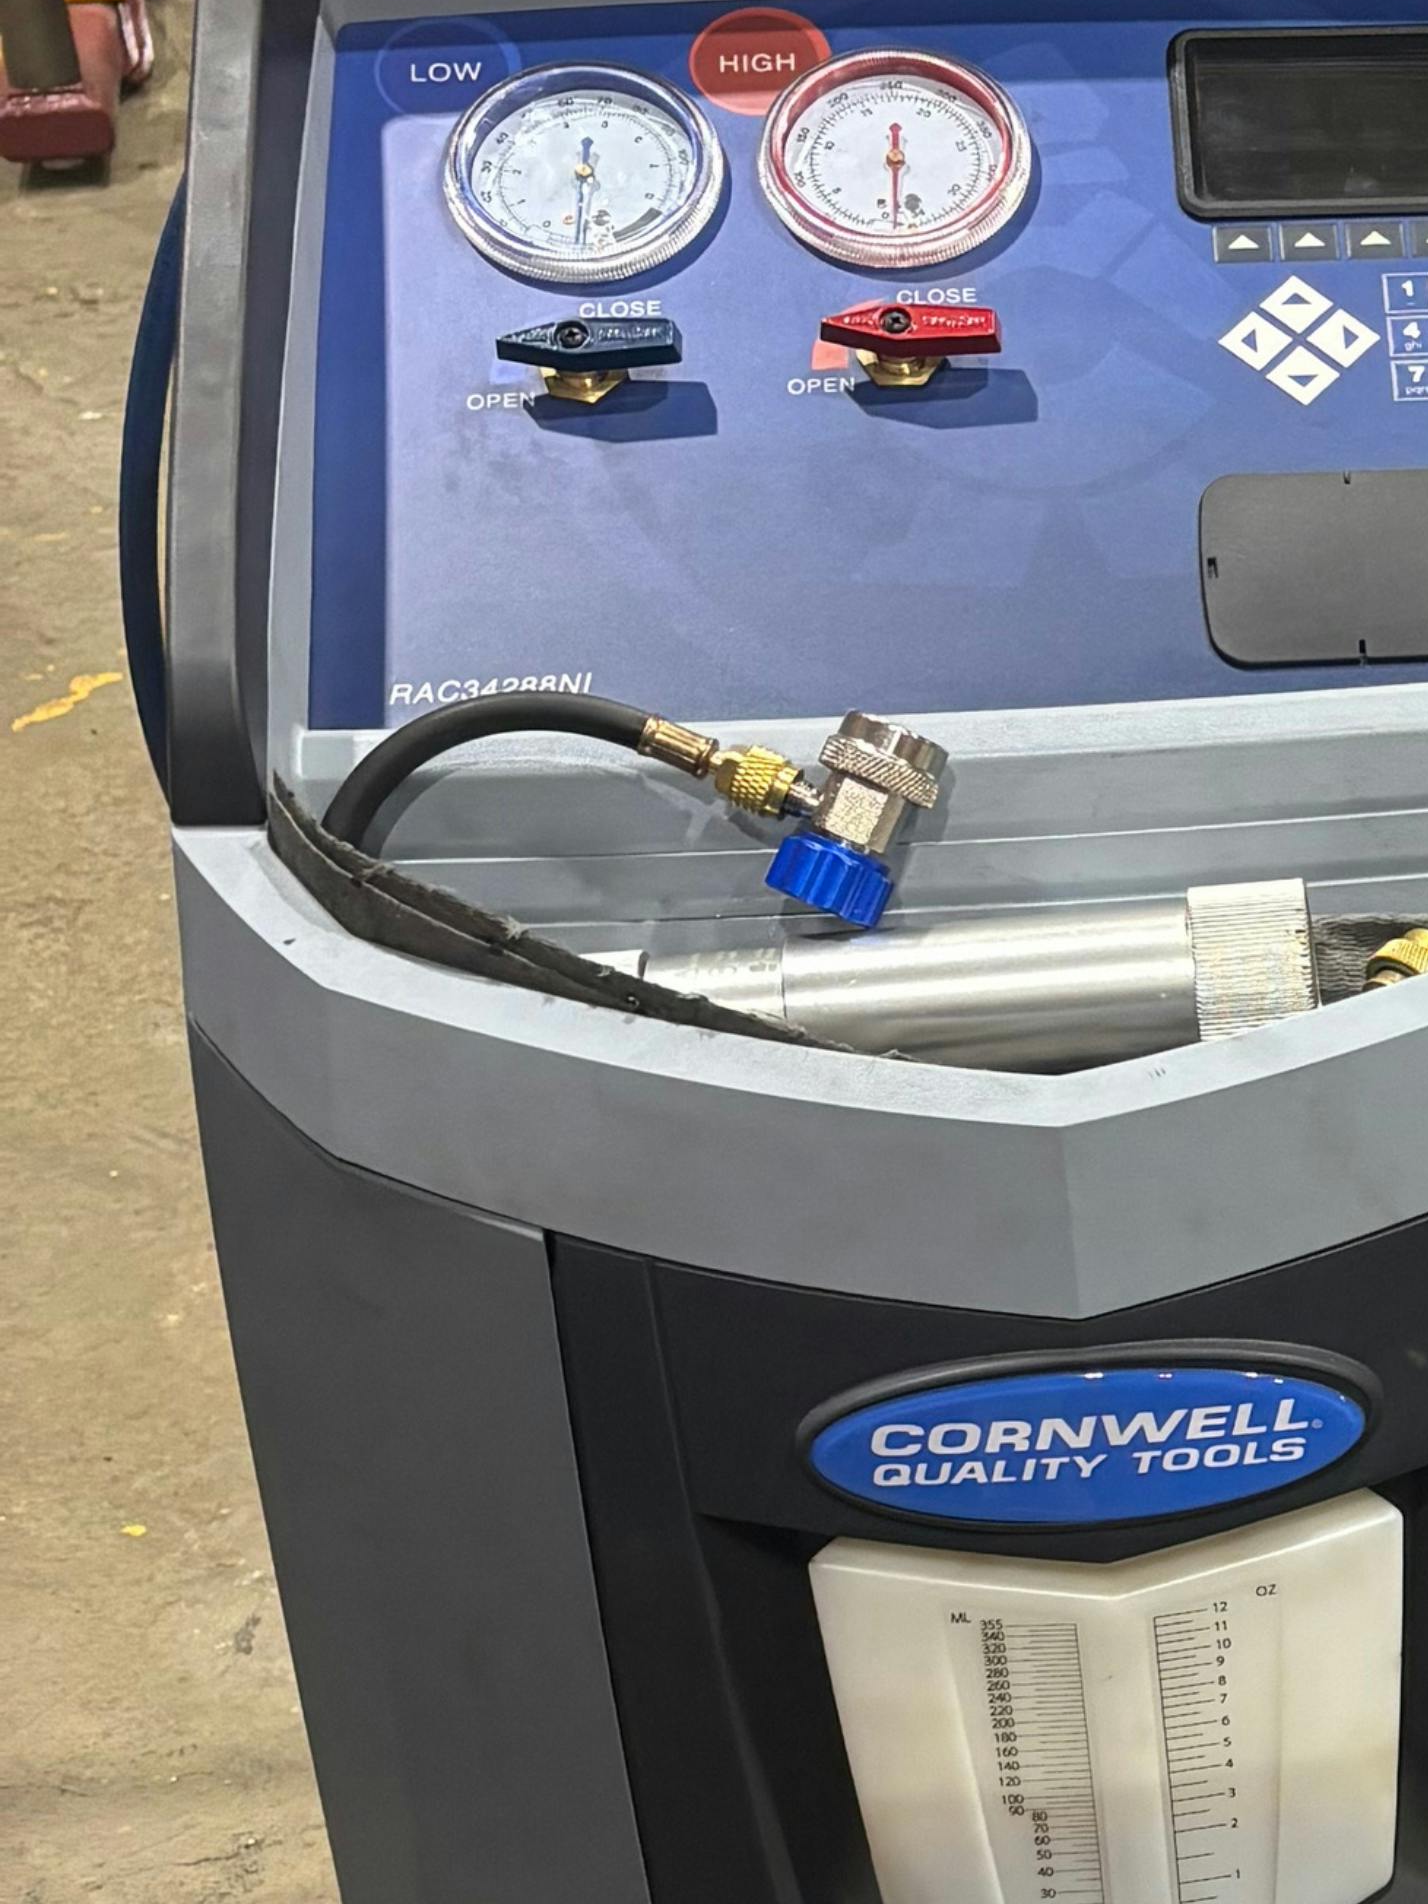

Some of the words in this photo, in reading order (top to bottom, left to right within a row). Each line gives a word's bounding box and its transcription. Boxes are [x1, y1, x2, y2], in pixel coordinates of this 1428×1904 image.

[719, 52, 796, 76] HIGH
[410, 61, 483, 84] LOW
[1401, 279, 1414, 297] 1
[896, 287, 977, 305] CLOSE
[579, 300, 662, 318] CLOSE
[1402, 321, 1421, 339] 4
[1408, 365, 1426, 383] 7
[786, 377, 856, 395] OPEN
[466, 391, 536, 410] OPEN
[870, 1399, 1308, 1457] CORNWELL
[873, 1455, 1106, 1488] QUALITY
[1132, 1436, 1307, 1476] TOOLS
[1255, 1584, 1278, 1597] OZ
[1213, 1601, 1228, 1613] 12
[951, 1612, 972, 1624] ML
[980, 1619, 1003, 1631] 355
[1214, 1620, 1228, 1631] 11
[981, 1631, 1005, 1642] 340
[983, 1643, 1007, 1654] 320
[1216, 1637, 1232, 1650] 10
[984, 1655, 1008, 1666] 300
[1216, 1655, 1225, 1667] 9
[985, 1667, 1010, 1679] 280
[987, 1679, 1011, 1692] 260
[1218, 1675, 1227, 1686] 8
[988, 1692, 1012, 1704] 240
[1220, 1692, 1228, 1704] 7
[989, 1704, 1013, 1717] 220
[992, 1717, 1015, 1729] 200
[1221, 1715, 1231, 1726] 6
[995, 1731, 1017, 1743] 180
[1223, 1737, 1232, 1747] 5
[996, 1746, 1019, 1757] 160
[997, 1760, 1020, 1772] 140
[1225, 1758, 1234, 1768] 4
[999, 1776, 1021, 1787] 120
[1228, 1787, 1236, 1798] 3
[1002, 1794, 1025, 1805] 100
[1008, 1805, 1025, 1817] 90
[1031, 1811, 1048, 1823] 80
[1033, 1822, 1050, 1834] 70
[1230, 1817, 1238, 1828] 2
[1034, 1834, 1051, 1846] 60
[1036, 1849, 1052, 1861] 50
[1037, 1866, 1054, 1877] 40
[1235, 1868, 1241, 1879] 1
[1040, 1888, 1056, 1899] 30
